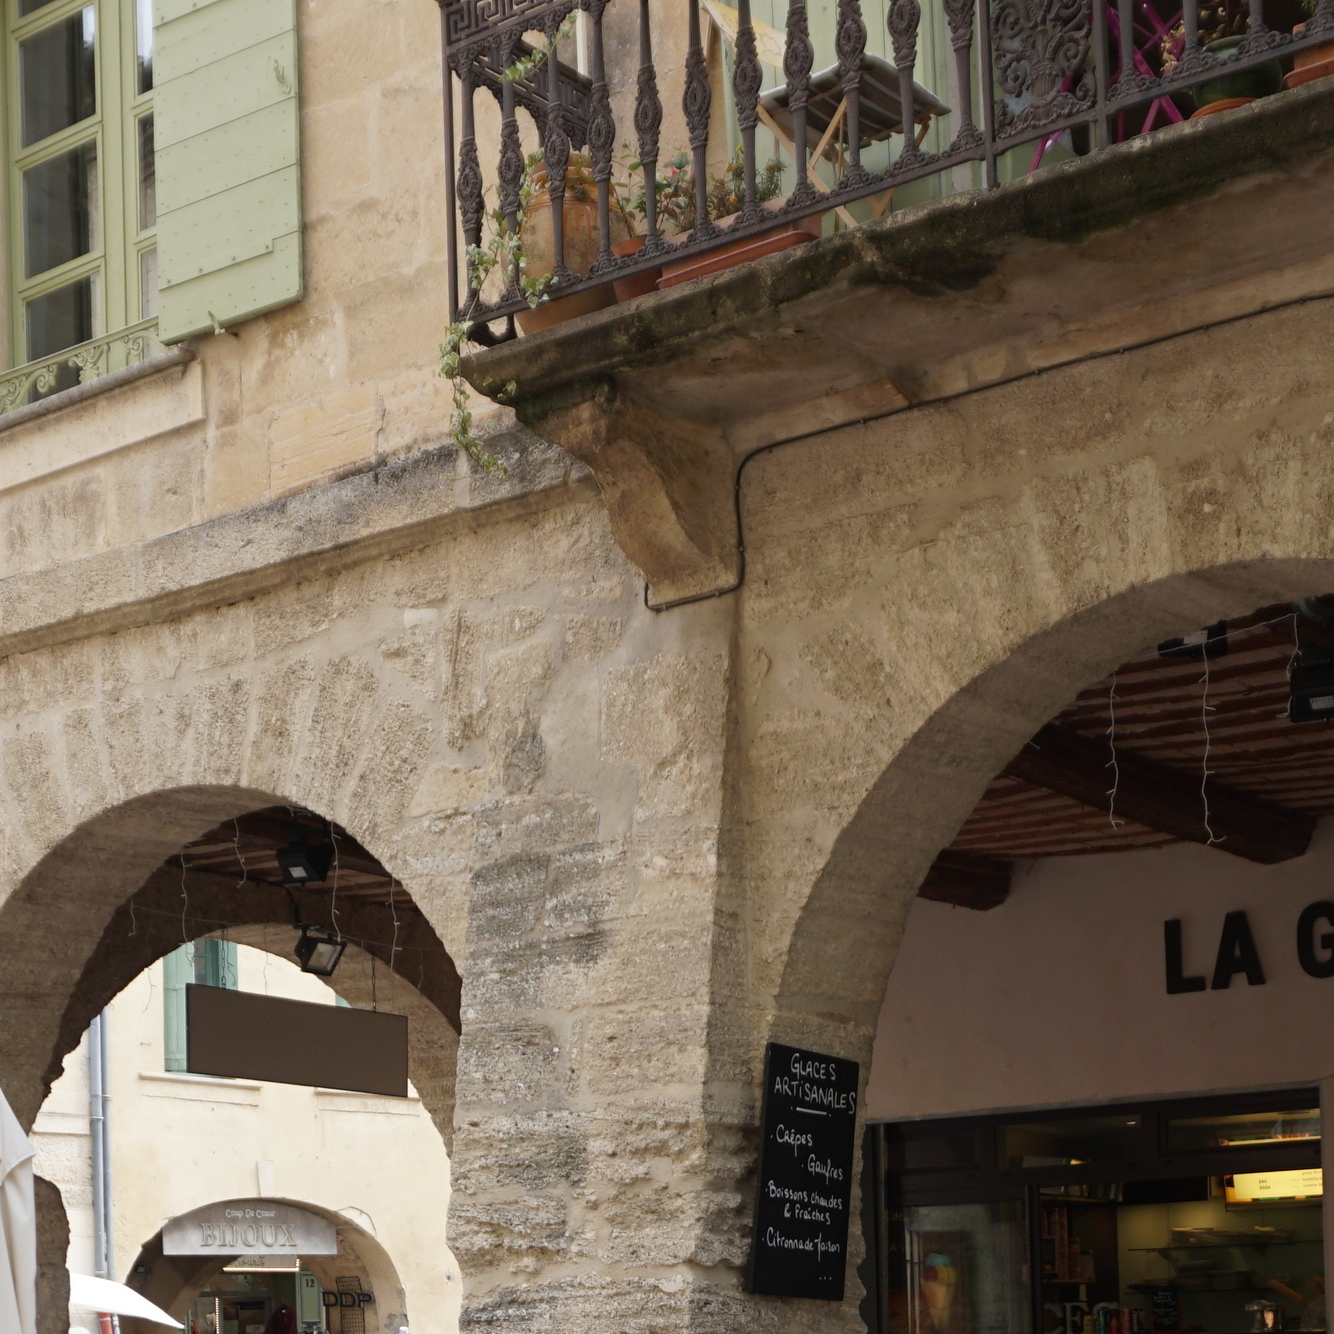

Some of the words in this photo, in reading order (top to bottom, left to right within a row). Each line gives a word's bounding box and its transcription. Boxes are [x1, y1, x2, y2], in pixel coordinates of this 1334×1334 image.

[1163, 910, 1266, 995] LA
[790, 1052, 837, 1081] GLACES
[807, 1153, 843, 1185] Gaufres
[768, 1179, 808, 1202] Boissons
[810, 1191, 843, 1210] chaudes
[225, 1209, 244, 1220] Coup
[245, 1208, 255, 1217] De
[200, 1222, 297, 1248] BIJOUX
[766, 1226, 814, 1252] Citronnade
[305, 1278, 315, 1288] 12
[321, 1291, 376, 1308] DDP
